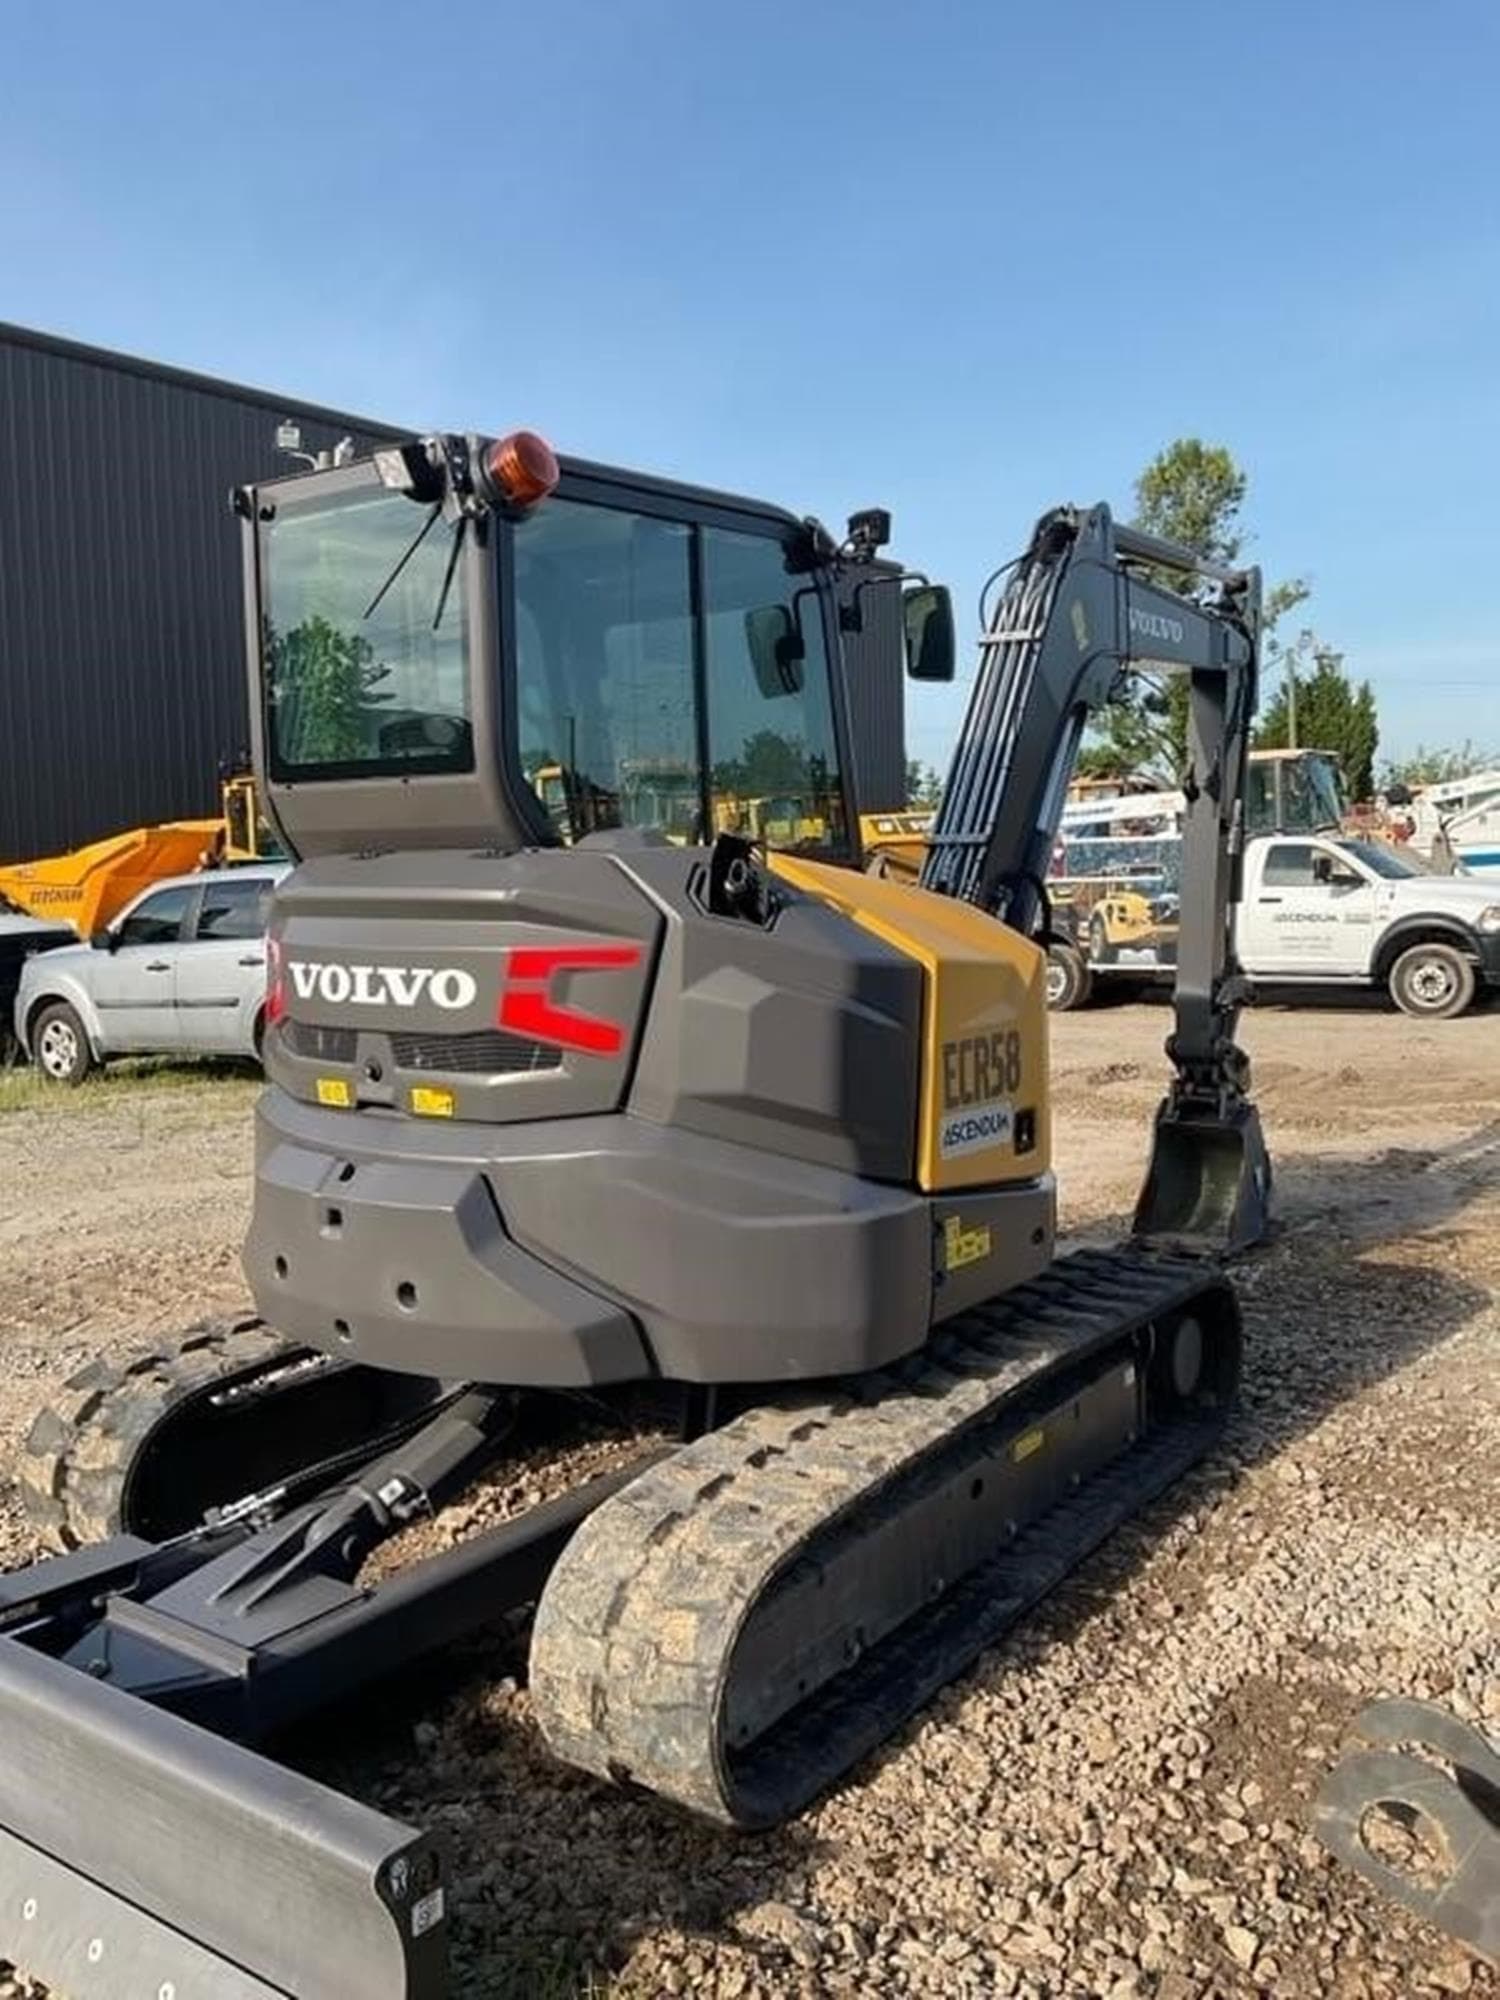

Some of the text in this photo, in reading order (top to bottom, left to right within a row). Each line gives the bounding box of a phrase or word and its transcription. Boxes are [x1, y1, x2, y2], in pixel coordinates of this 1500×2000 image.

[1128, 606, 1183, 643] VOLVO
[288, 961, 477, 1010] VOLVO
[943, 1030, 1020, 1109] ECR58
[943, 1112, 1009, 1147] ASCENDUM
